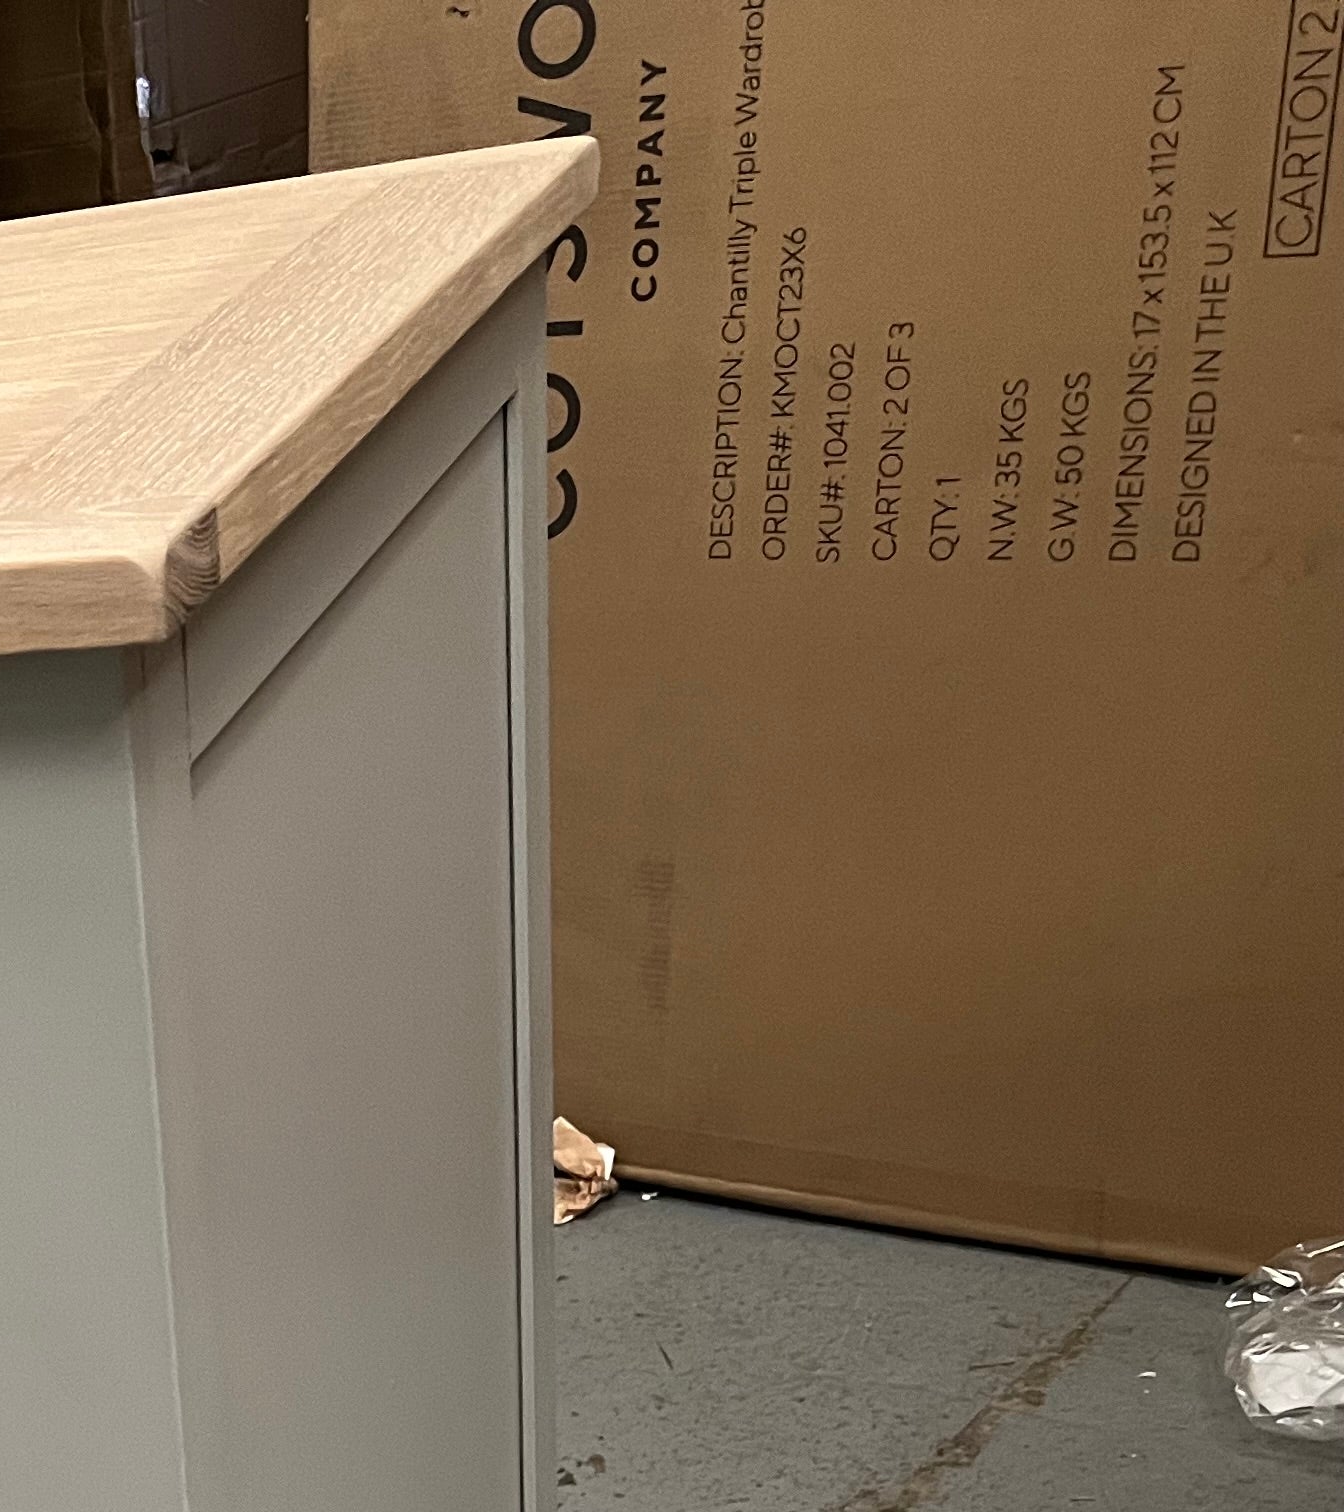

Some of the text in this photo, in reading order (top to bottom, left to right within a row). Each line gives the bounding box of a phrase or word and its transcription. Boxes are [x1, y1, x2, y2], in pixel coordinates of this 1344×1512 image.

[1153, 66, 1185, 123] CM
[1275, 9, 1339, 247] CARTON 2
[631, 59, 667, 302] COMPANY
[729, 131, 761, 214] Triple
[1147, 131, 1179, 175] 112
[721, 219, 758, 344] Chantilly
[1138, 205, 1172, 283] 153.5
[771, 227, 807, 417] KMOCT23X6
[1132, 311, 1160, 338] 17
[1195, 274, 1230, 343] THE
[824, 342, 855, 468] 1041.002
[1060, 372, 1091, 436] KGS
[1192, 350, 1223, 383] IN
[709, 351, 744, 559] DESCRIPTION:
[872, 322, 914, 561] CARTON: 2 OF 3
[988, 379, 1029, 560] N.W: 35 KGS
[1055, 445, 1084, 484] 50
[1108, 346, 1158, 561] DIMENSIONS:
[1172, 391, 1216, 562] DESIGNED
[929, 478, 961, 561] QTY: 1
